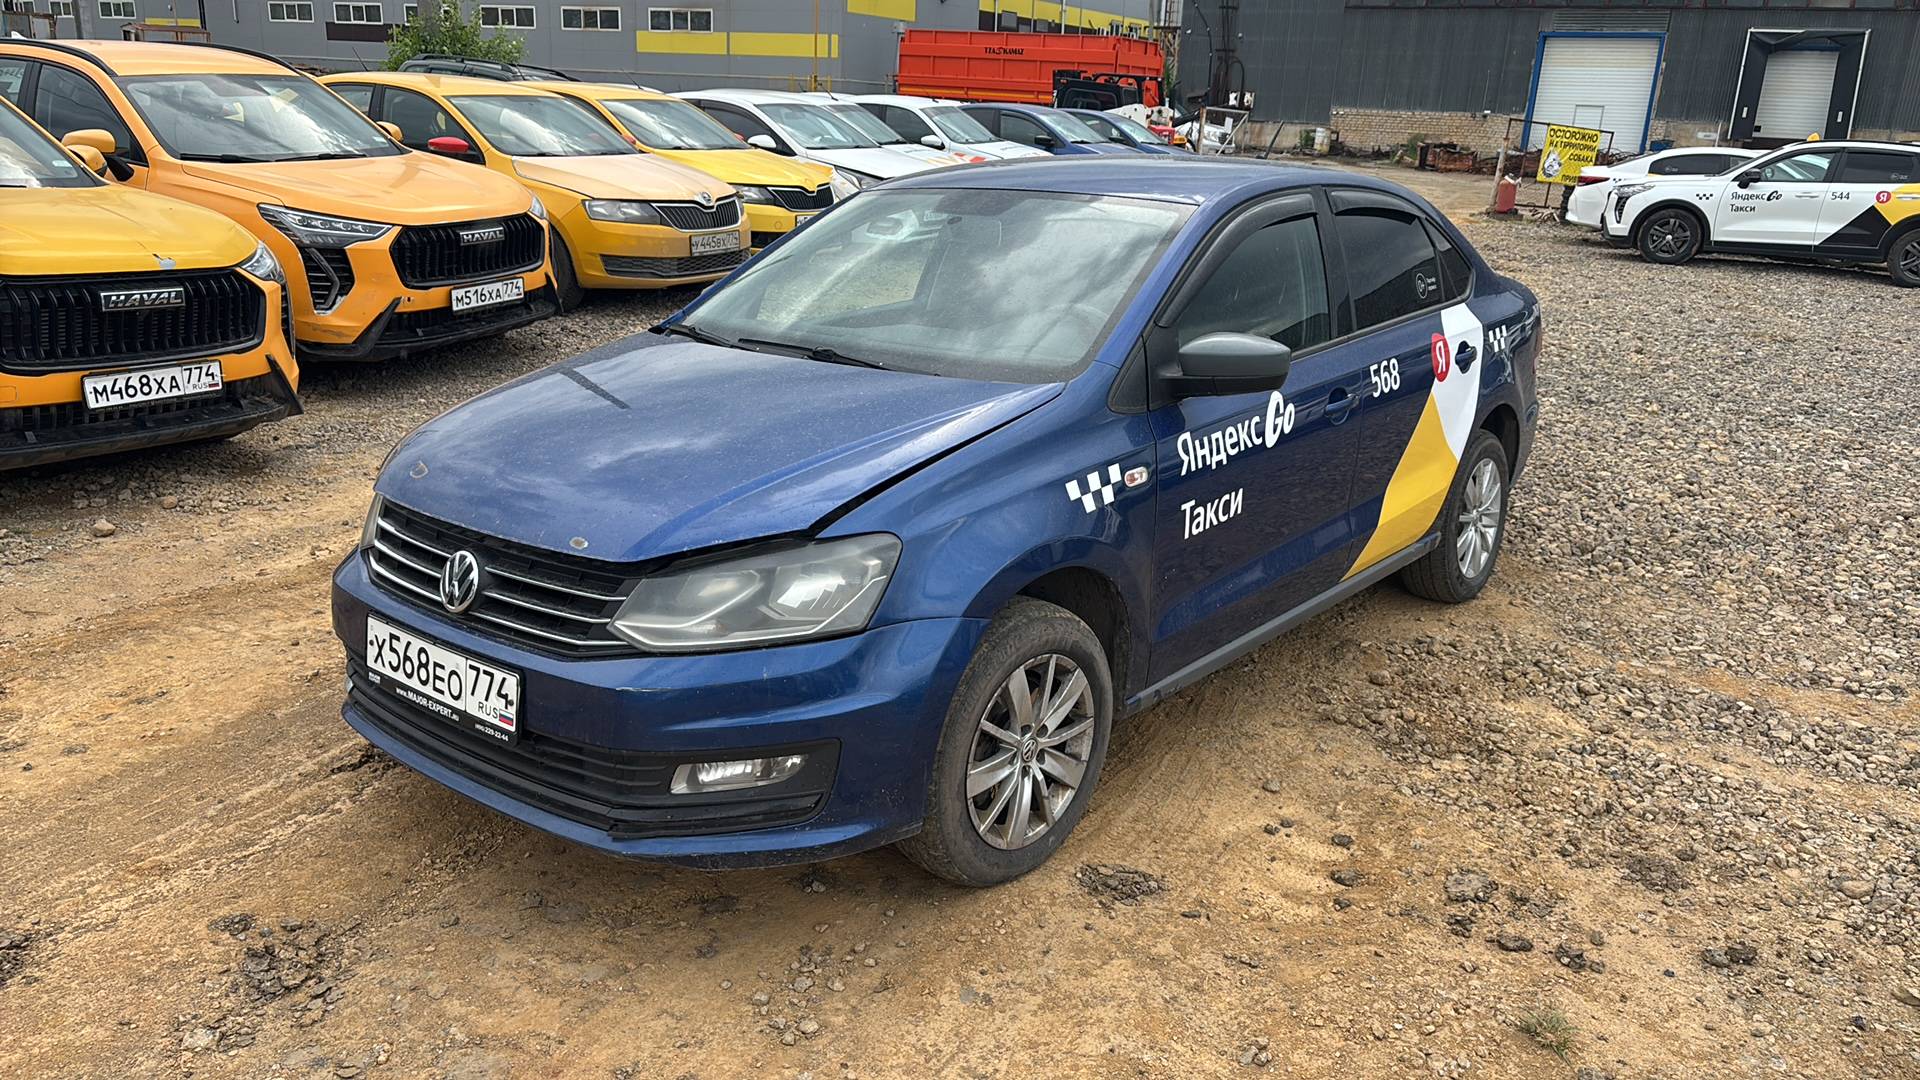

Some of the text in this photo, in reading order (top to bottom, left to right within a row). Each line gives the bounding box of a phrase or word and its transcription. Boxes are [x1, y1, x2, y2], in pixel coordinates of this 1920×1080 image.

[1549, 128, 1598, 143] ОСТОРОЖНО
[1549, 140, 1597, 152] НА ТЕРРИТОРИИ
[1568, 152, 1594, 163] СОБАКА
[1731, 190, 1783, 202] Яндекс Go
[1831, 191, 1850, 201] 544
[1879, 192, 1888, 202] Я
[1730, 203, 1756, 212] Такси
[464, 230, 503, 243] HAVAL
[108, 291, 182, 308] HAVAL
[456, 281, 521, 307] М516ХА 774
[1435, 340, 1446, 375] Я
[92, 365, 215, 403] М468ХА 774
[1369, 357, 1401, 398] 568
[192, 382, 208, 390] RUS
[1176, 390, 1296, 477] Яндекс Go
[1180, 487, 1244, 540] Такси
[373, 632, 509, 710] Х568ЕО 774
[478, 701, 499, 719] RUS
